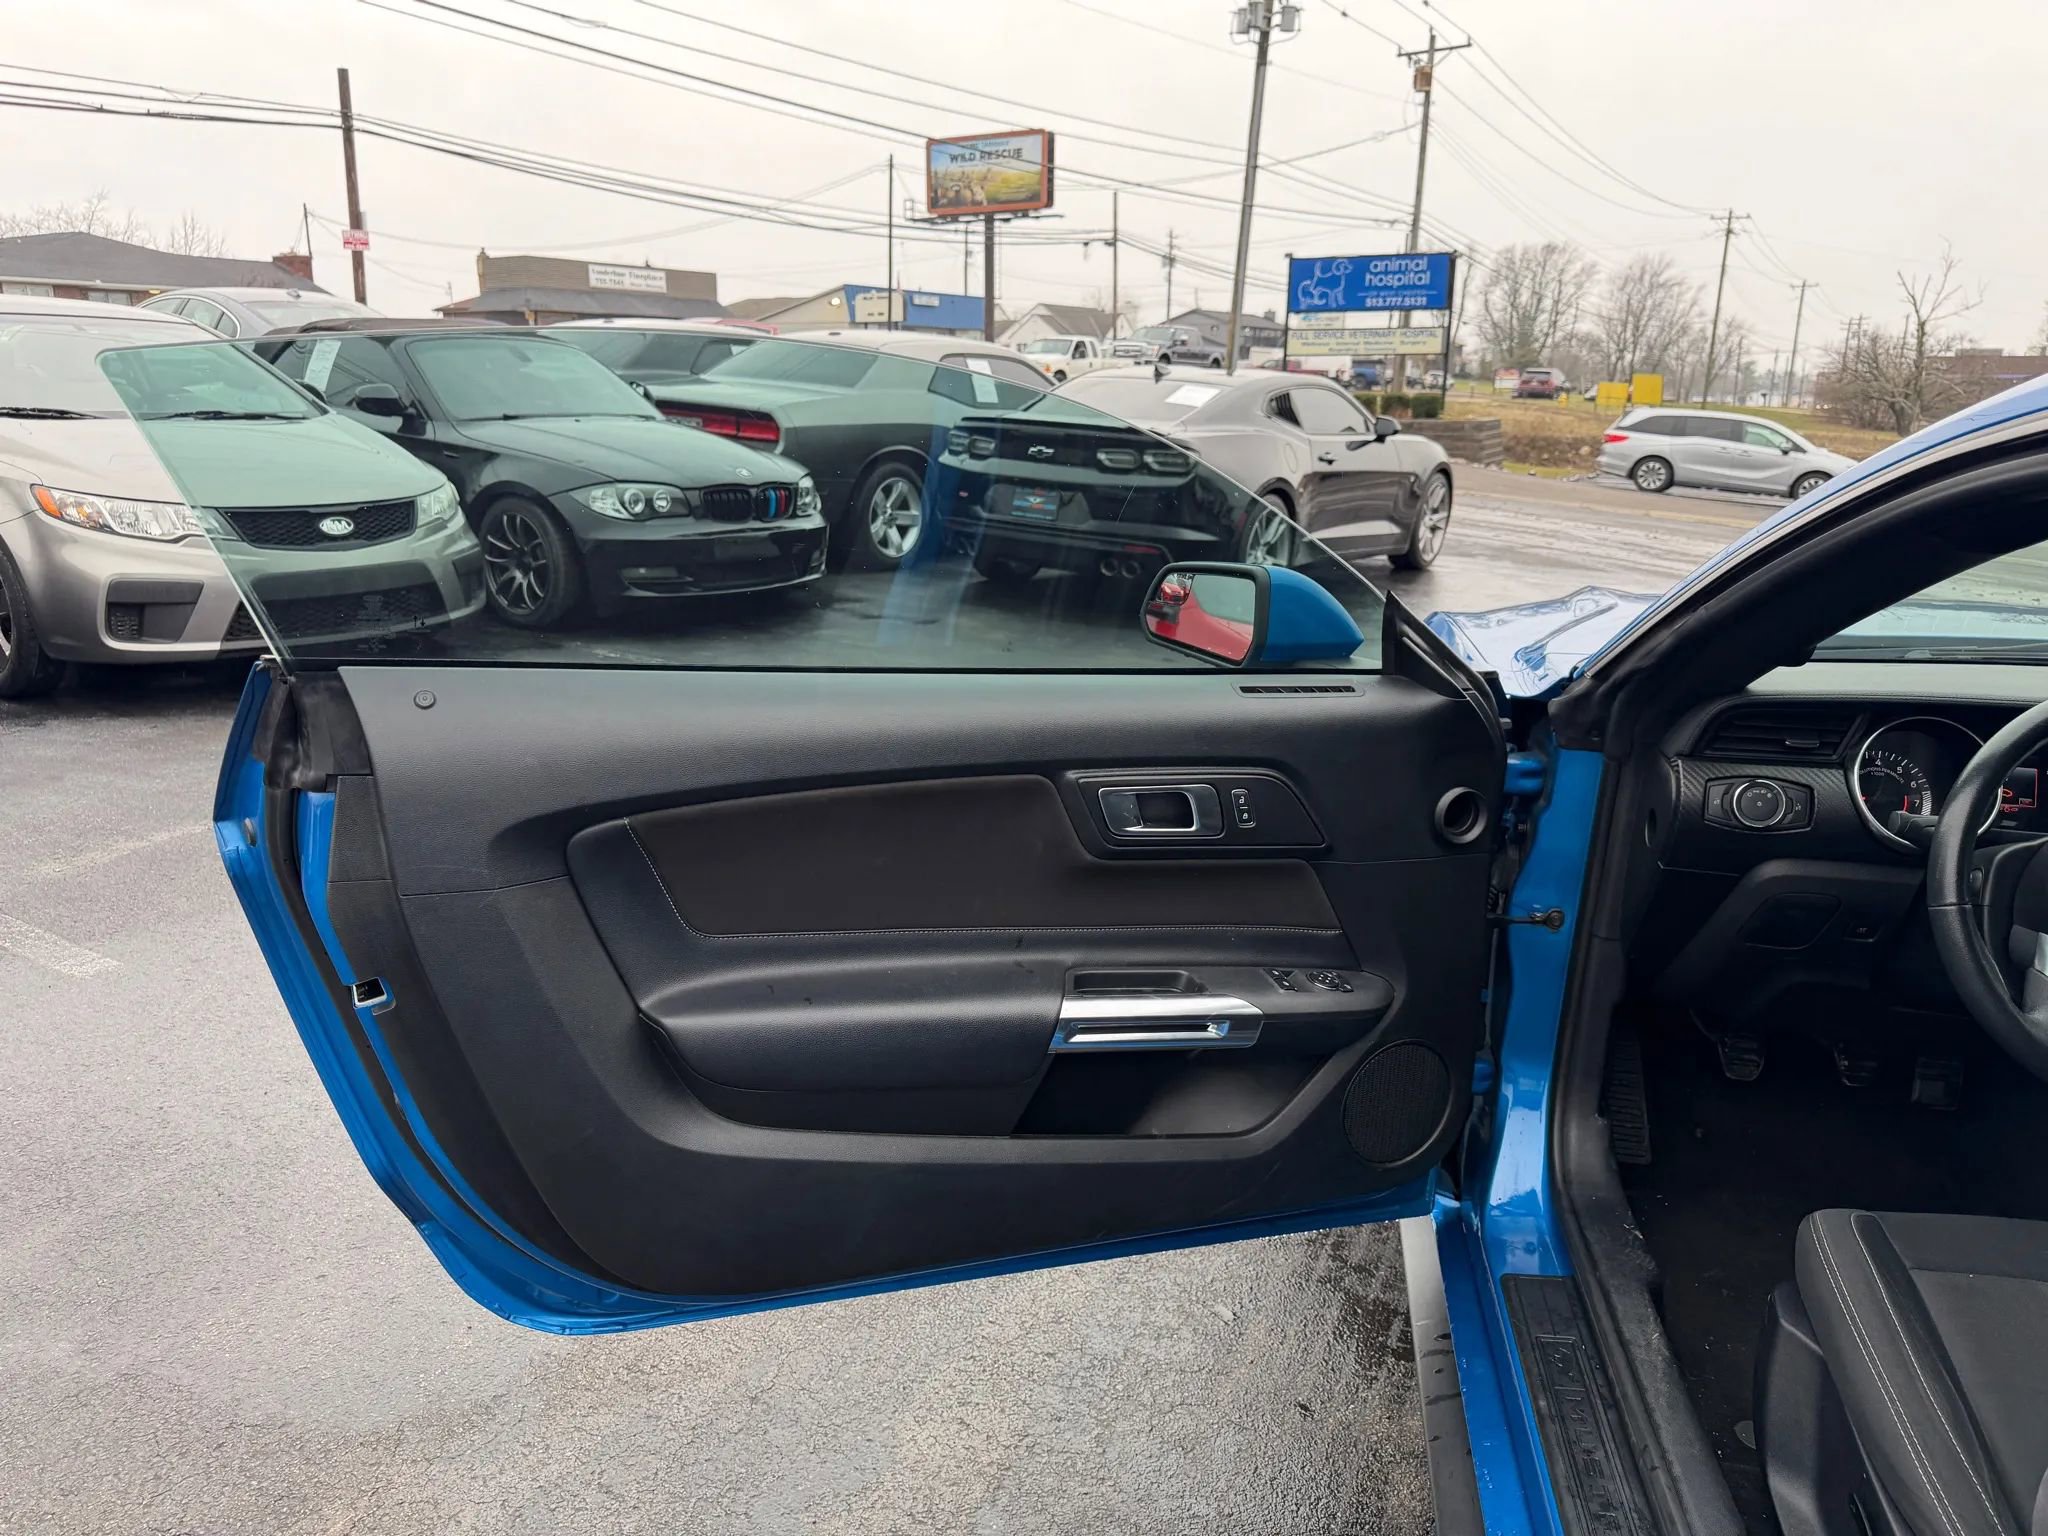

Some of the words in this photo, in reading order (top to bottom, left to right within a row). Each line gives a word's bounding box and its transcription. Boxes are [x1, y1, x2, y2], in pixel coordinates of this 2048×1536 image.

[949, 152, 976, 164] WILD
[980, 148, 1023, 160] RESCUE
[1369, 256, 1428, 273] animal
[1364, 270, 1431, 288] hospital
[1875, 758, 1881, 766] 4
[1896, 766, 1903, 774] 5
[1910, 780, 1917, 788] 6
[1914, 799, 1920, 807] 7
